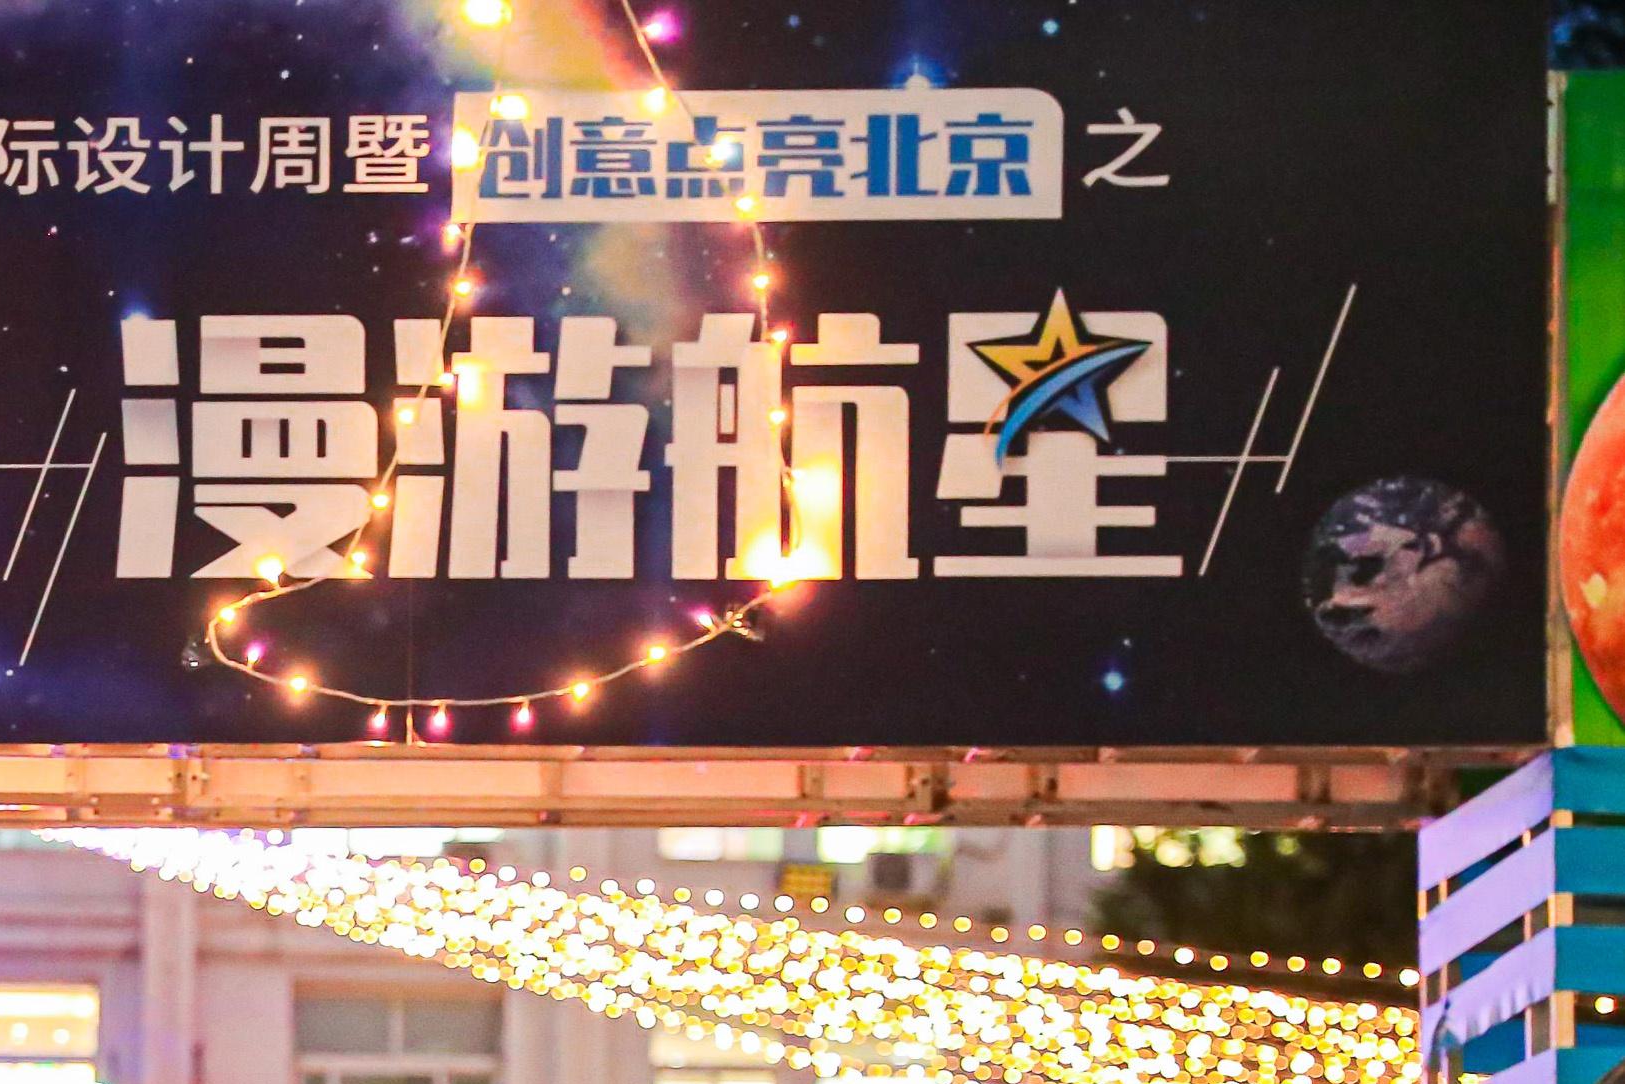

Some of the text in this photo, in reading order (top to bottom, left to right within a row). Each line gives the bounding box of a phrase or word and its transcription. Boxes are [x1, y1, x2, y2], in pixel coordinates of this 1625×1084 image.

[478, 114, 1034, 199] 创意点亮北京
[1084, 108, 1171, 188] 之
[115, 312, 1183, 579] 漫游航星
